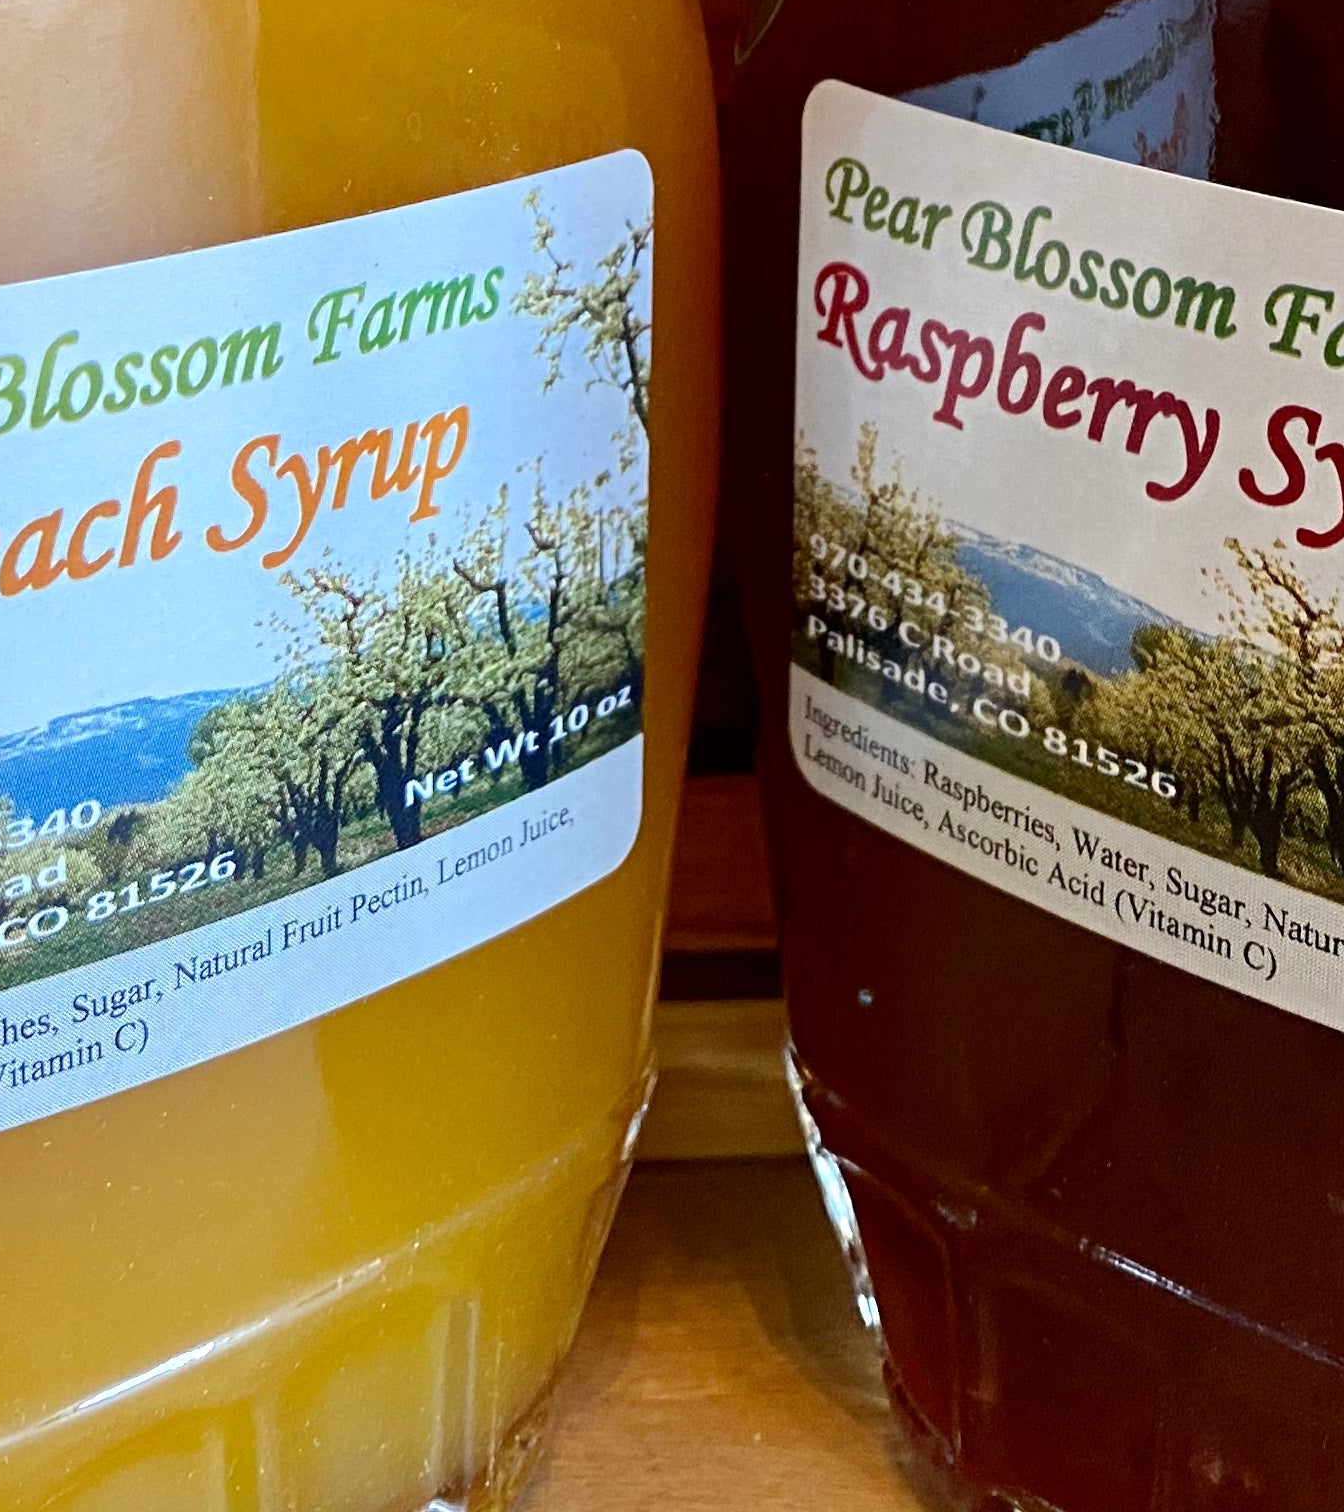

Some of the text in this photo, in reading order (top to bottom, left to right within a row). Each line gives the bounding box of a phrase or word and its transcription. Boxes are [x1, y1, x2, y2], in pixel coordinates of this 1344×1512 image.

[307, 265, 506, 366] Farms
[826, 157, 953, 250] Pear
[961, 200, 1236, 340] Blossom
[814, 261, 1220, 501] Raspberry
[206, 405, 471, 567] Syrup
[809, 533, 1061, 662] 970-434-3340
[809, 575, 1031, 699] 3376 C Road
[403, 685, 633, 808] Net Wt 10 oz
[807, 615, 1178, 799] Palisade, CO 81526
[85, 850, 237, 924] 81526
[804, 696, 915, 776] Ingredients:
[923, 760, 1061, 851] Raspberries,
[1072, 826, 1154, 889] Water,
[1166, 867, 1252, 928] Sugar,
[804, 733, 1277, 981] Lemon Juice, Ascorbic Acid (Vitamin C)
[70, 977, 164, 1025] Sugar,
[173, 927, 271, 990] Natural
[281, 905, 343, 952] Fruit
[350, 873, 429, 922] Pectin,
[436, 836, 513, 886] Lemon
[519, 805, 575, 853] Juice,
[113, 1019, 150, 1055] C)
